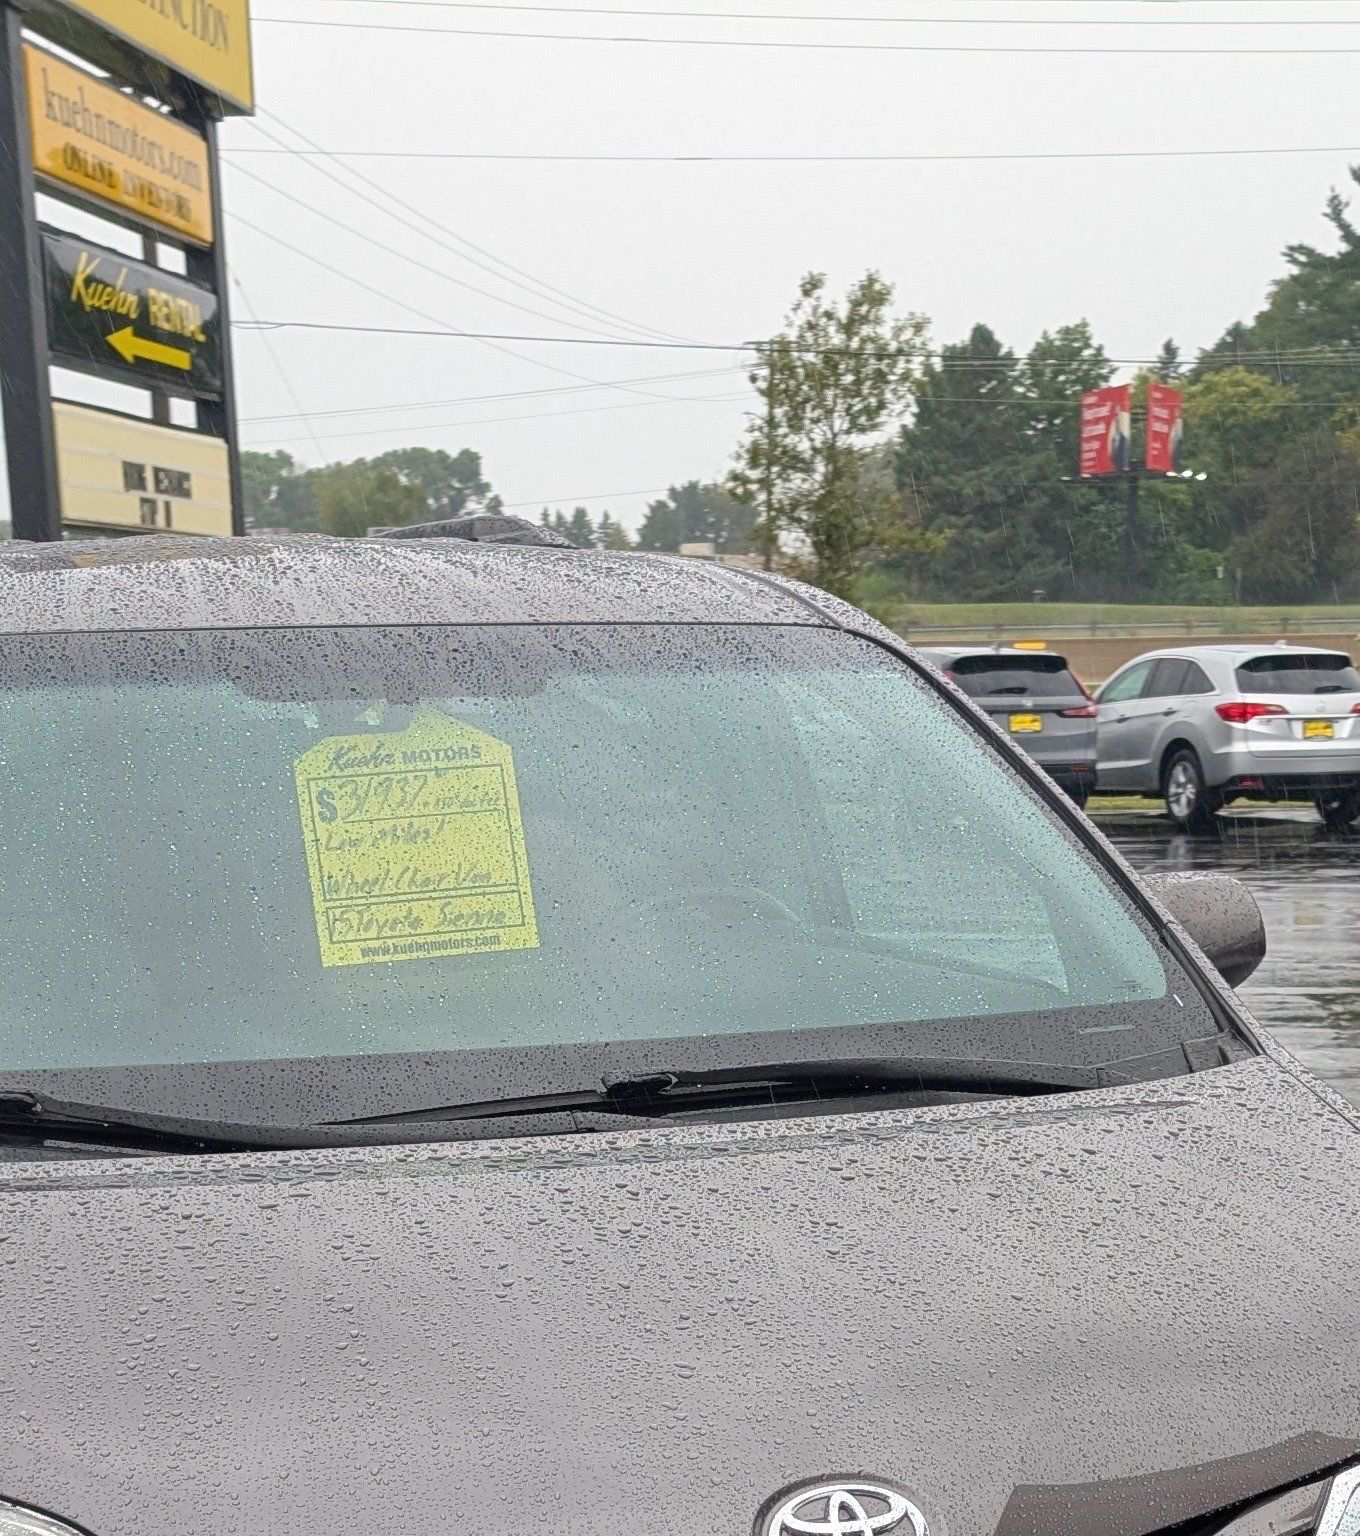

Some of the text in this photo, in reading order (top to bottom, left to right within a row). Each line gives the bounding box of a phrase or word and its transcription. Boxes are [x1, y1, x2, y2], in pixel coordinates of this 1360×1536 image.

[41, 67, 202, 191] kuehnmotors.com
[70, 250, 141, 320] Kuehn
[326, 741, 482, 772] Kuehn MOTORS
[360, 935, 501, 958] www.kuehnmotors.com
